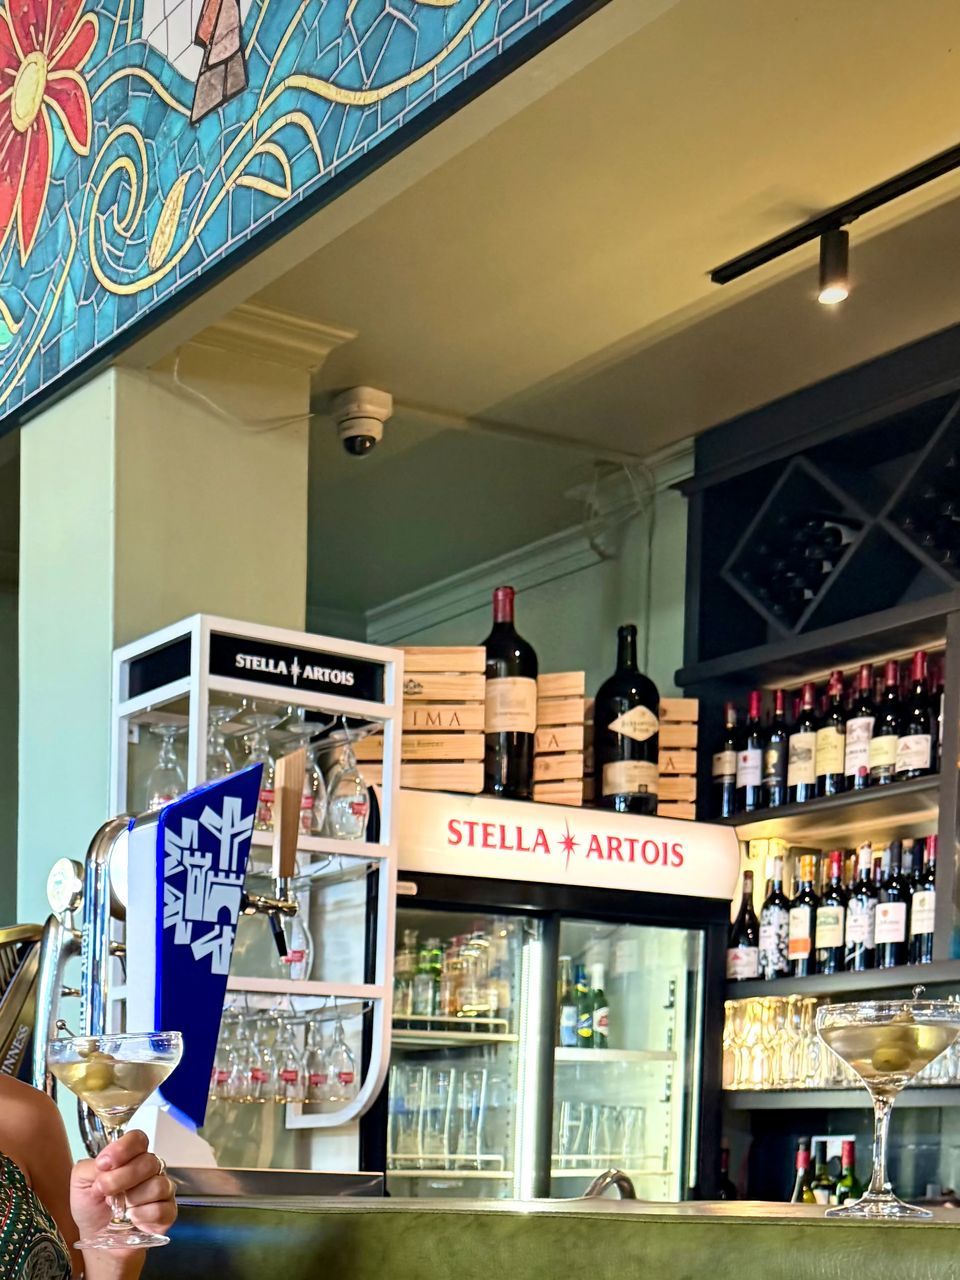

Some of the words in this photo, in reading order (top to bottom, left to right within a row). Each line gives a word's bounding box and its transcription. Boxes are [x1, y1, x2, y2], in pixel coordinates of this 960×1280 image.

[235, 654, 288, 676] STELLA
[302, 666, 354, 686] ARTOIS
[447, 818, 551, 855] STELLA
[586, 834, 684, 868] ARTOIS
[0, 1023, 29, 1074] INNESS
